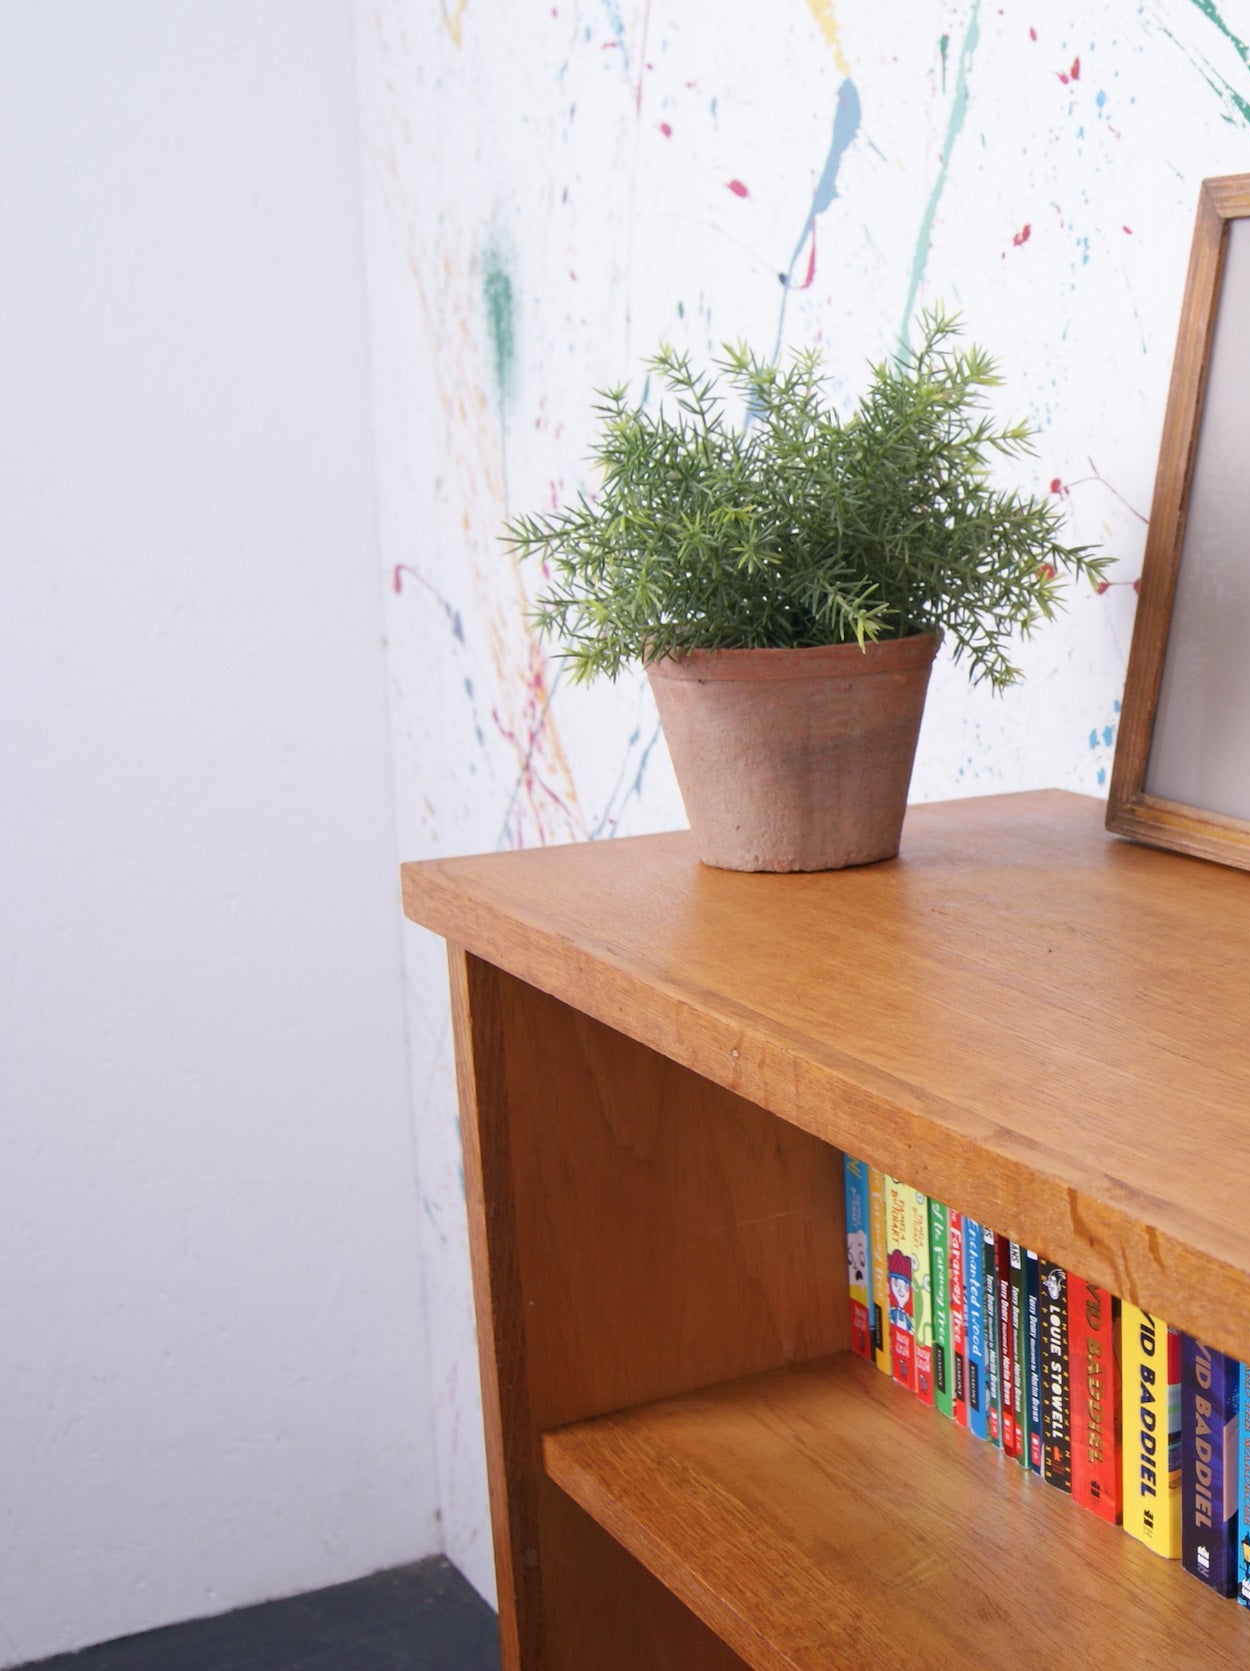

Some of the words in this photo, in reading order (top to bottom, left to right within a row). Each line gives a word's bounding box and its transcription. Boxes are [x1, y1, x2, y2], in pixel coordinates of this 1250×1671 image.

[891, 1188, 900, 1243] BUTCHART
[896, 1199, 905, 1241] PAMELA
[931, 1203, 943, 1221] of
[934, 1247, 944, 1307] Faraway
[951, 1227, 961, 1306] Faraway
[967, 1218, 981, 1309] Enchanted
[986, 1274, 994, 1295] Terry
[1000, 1279, 1008, 1301] Terry
[1011, 1285, 1020, 1307] Terry
[987, 1293, 995, 1317] Deary
[1001, 1299, 1009, 1324] Deary
[1012, 1305, 1020, 1330] Deary
[1028, 1294, 1038, 1317] Terry
[953, 1310, 963, 1345] Tree
[971, 1310, 982, 1358] Wood
[1029, 1315, 1038, 1340] Deary
[1050, 1304, 1062, 1357] LOUIE
[989, 1349, 997, 1376] Martin
[1002, 1355, 1010, 1382] Martin
[1003, 1380, 1011, 1406] Brown
[1030, 1371, 1039, 1401] Martin
[1051, 1361, 1064, 1439] STOWELL
[1087, 1338, 1103, 1463] BADDIEL
[1140, 1363, 1156, 1498] BADDIEL
[1195, 1394, 1212, 1528] BADDIEL
